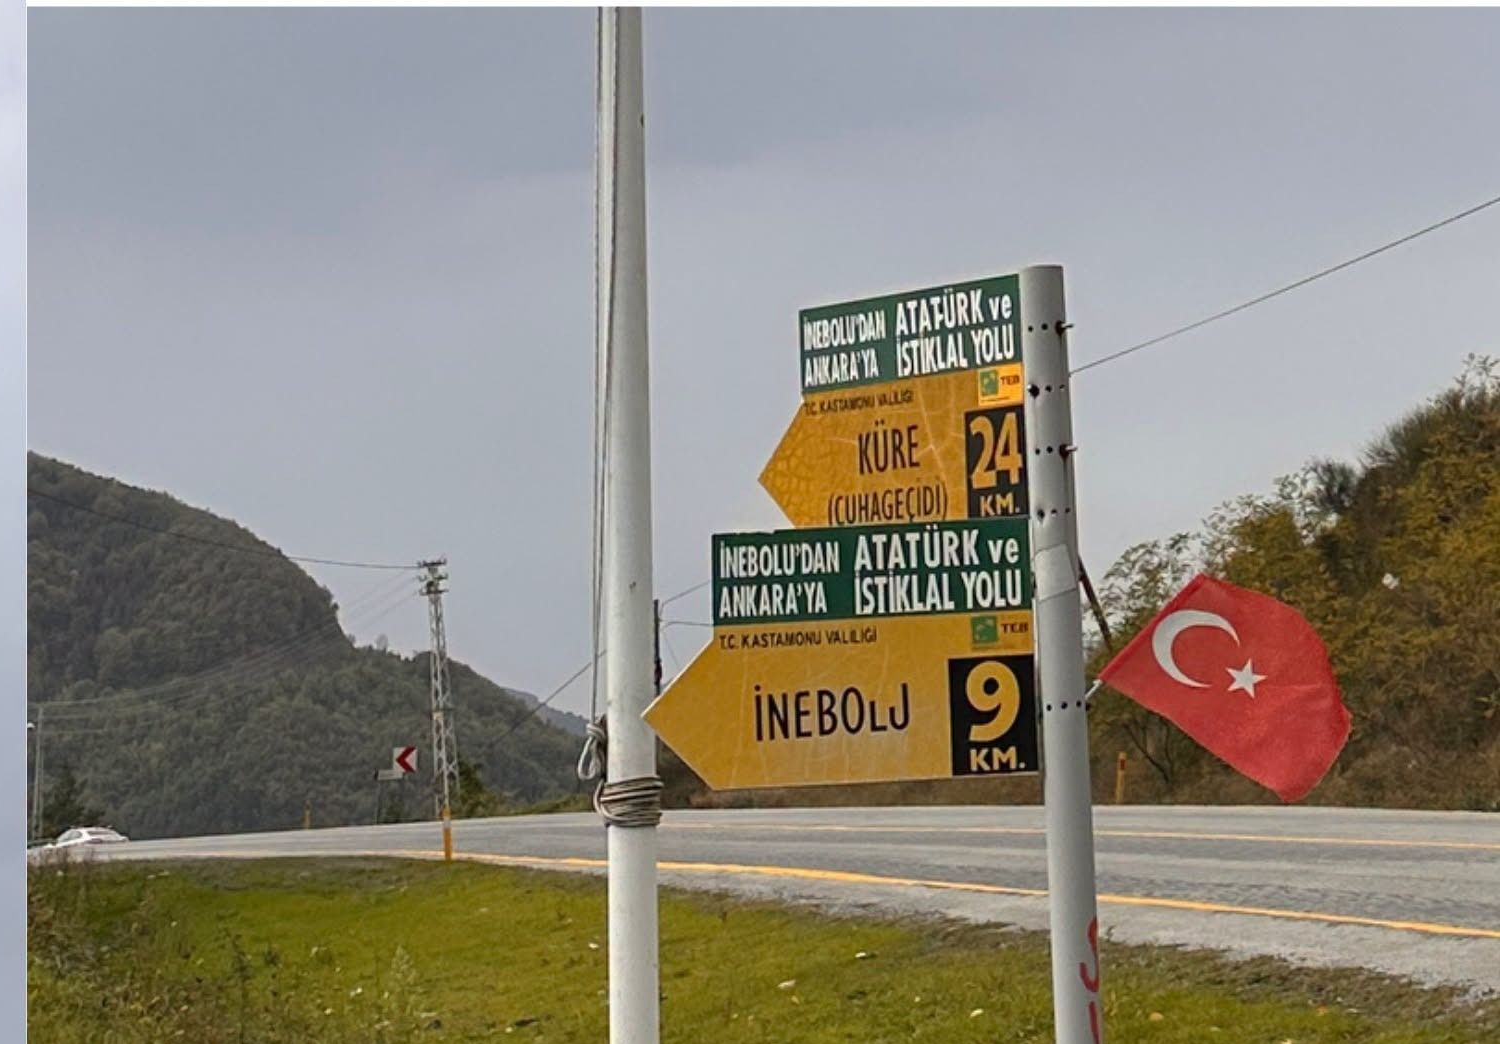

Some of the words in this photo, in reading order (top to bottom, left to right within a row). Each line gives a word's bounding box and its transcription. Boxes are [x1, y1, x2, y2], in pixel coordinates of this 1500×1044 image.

[804, 310, 886, 350] İNEBOLU'DAN
[896, 288, 984, 335] ATATÜRK
[989, 294, 1012, 321] ve
[805, 348, 879, 387] ANKARA'YA
[896, 332, 968, 377] İSTİKLAL
[971, 323, 1014, 366] YOLU
[858, 419, 920, 475] KÜRE
[970, 412, 1023, 489] 24
[979, 492, 1020, 517] KM.
[720, 540, 840, 579] İNEBOLU'DAN
[854, 525, 980, 571] ATATÜRK
[987, 538, 1019, 564] ve
[719, 581, 827, 618] ANKARA'YA
[854, 569, 955, 615] İSTİKLAL
[961, 569, 1022, 609] YOLU
[741, 631, 821, 649] KASTAMONU
[966, 660, 1021, 743] 9
[969, 745, 1026, 771] KM.
